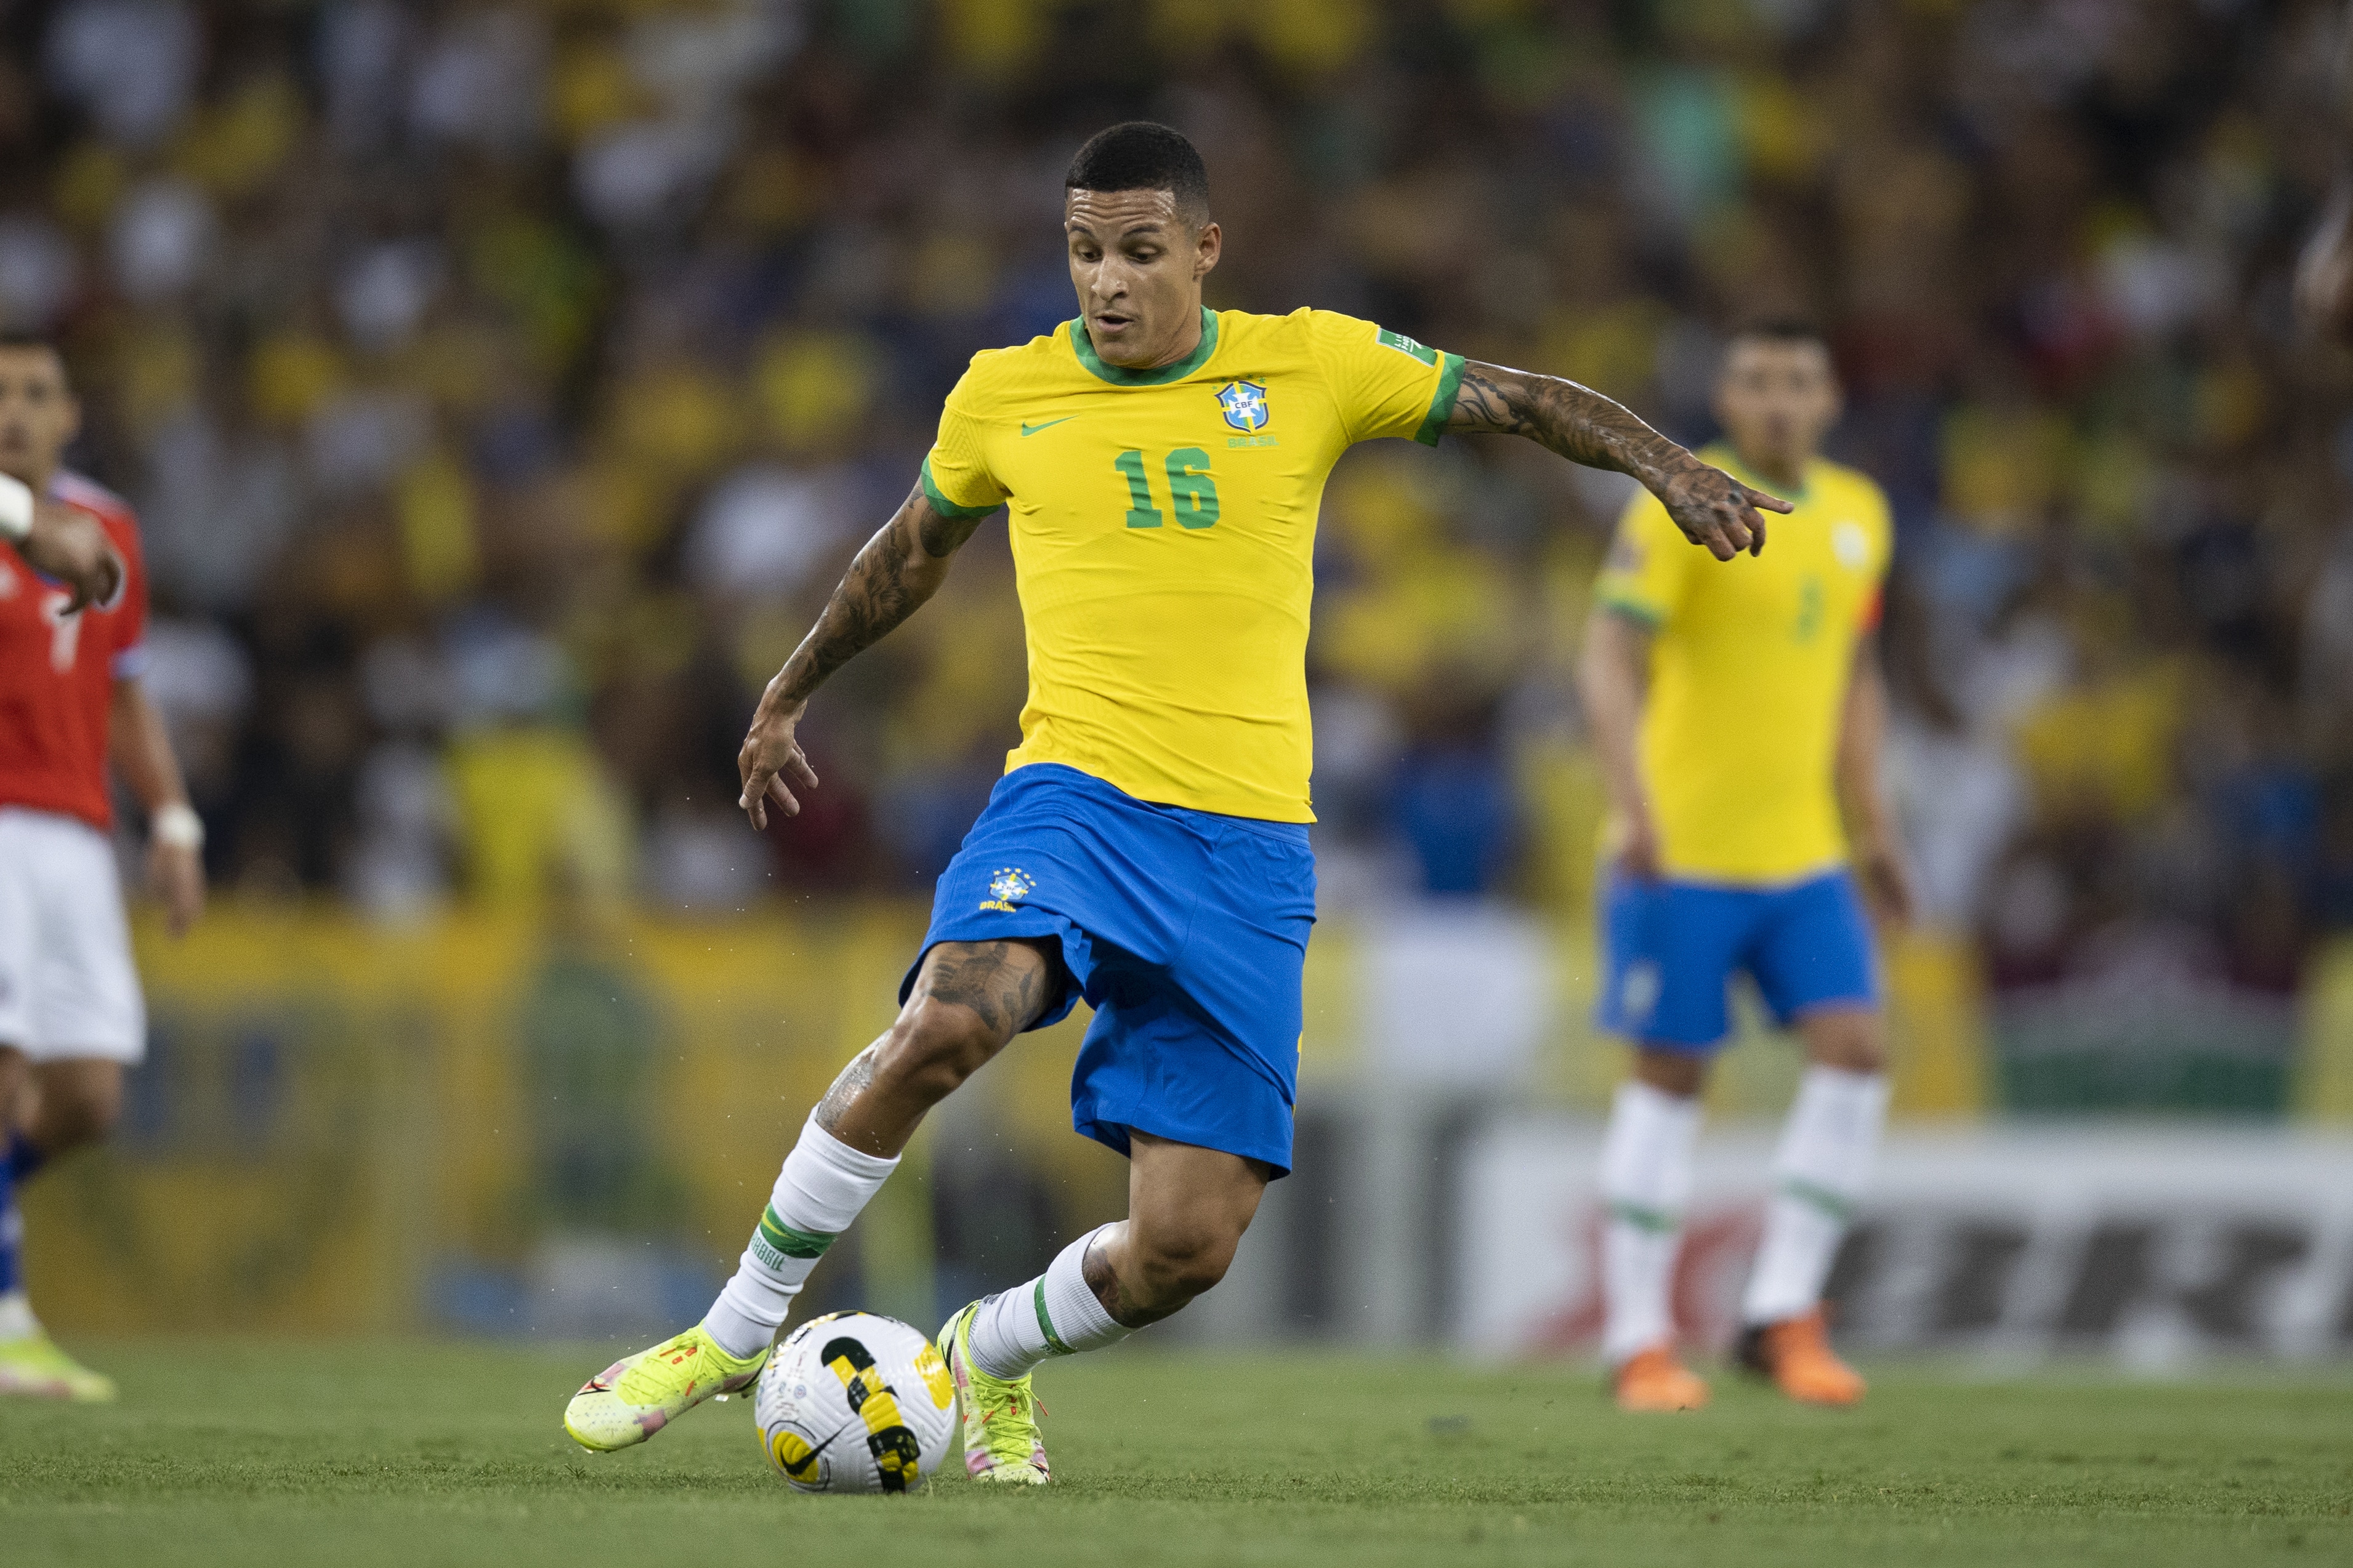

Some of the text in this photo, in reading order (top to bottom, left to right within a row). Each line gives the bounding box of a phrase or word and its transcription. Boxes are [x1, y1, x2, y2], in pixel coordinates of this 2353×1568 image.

[1235, 401, 1253, 409] CBF
[1227, 436, 1280, 448] BRASIL
[1115, 448, 1219, 529] 16
